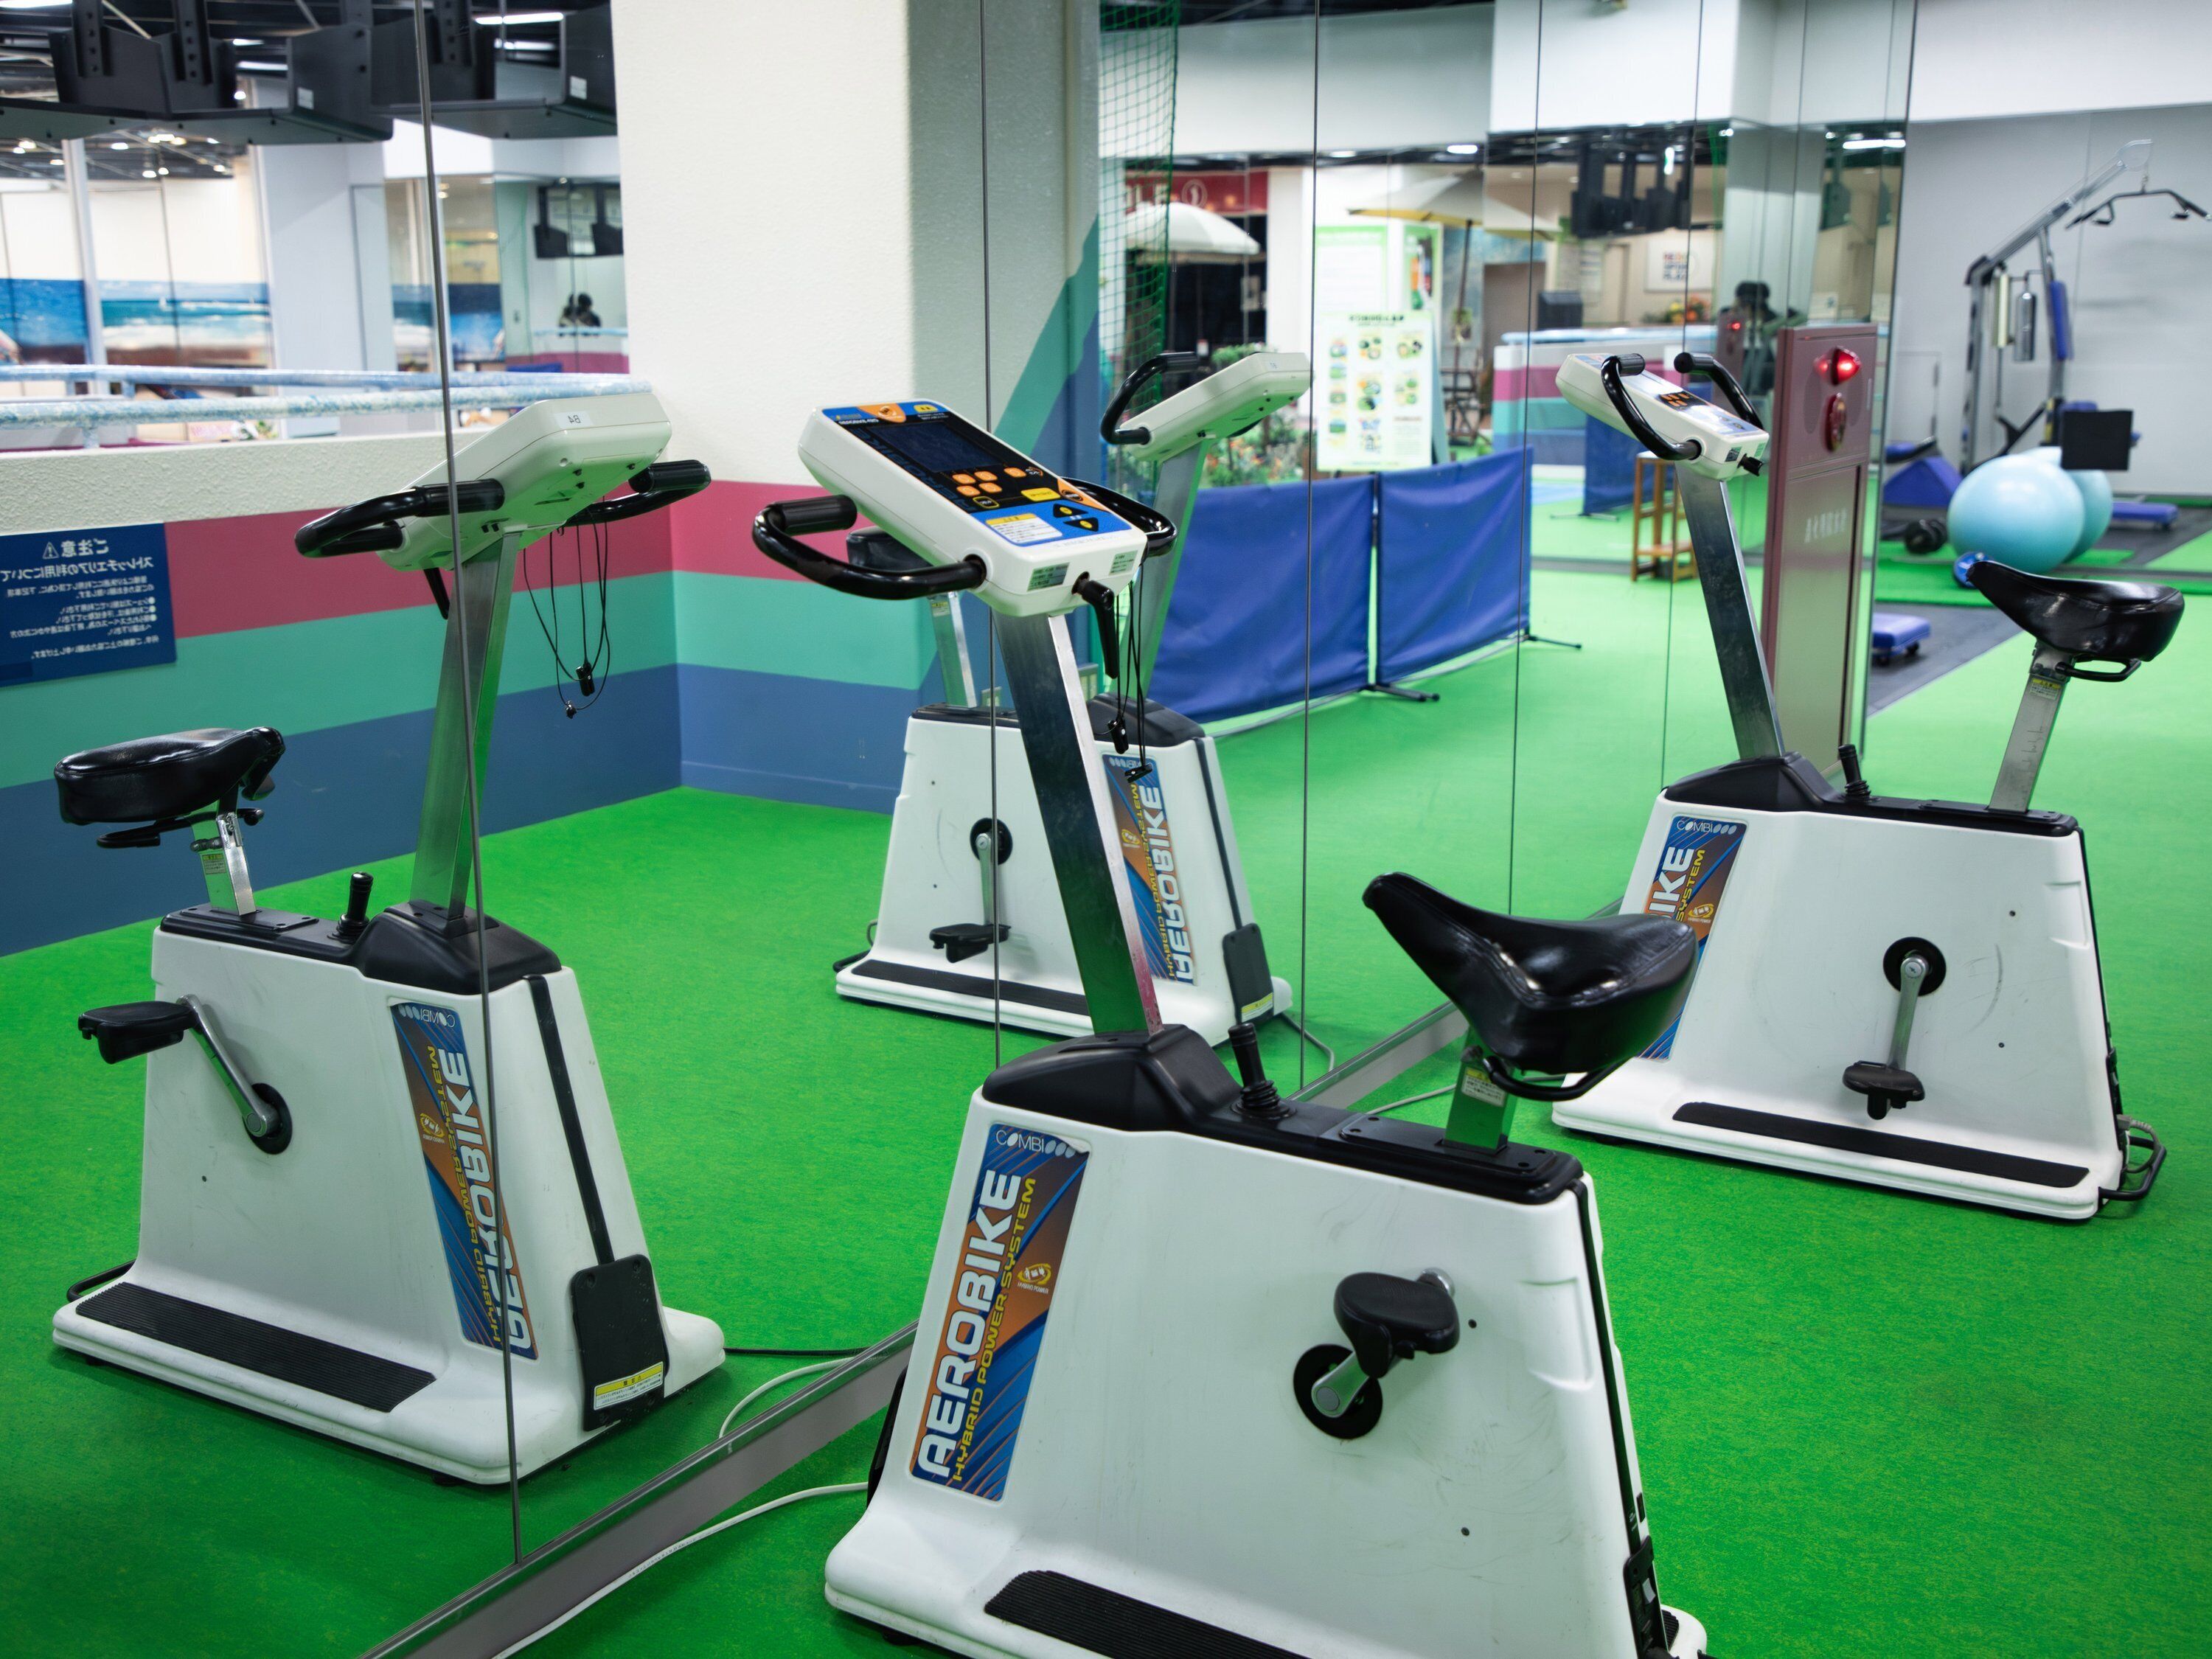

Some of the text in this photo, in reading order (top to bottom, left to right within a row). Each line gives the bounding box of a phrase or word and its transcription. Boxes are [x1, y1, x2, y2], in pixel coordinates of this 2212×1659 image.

[1648, 846, 1694, 918] IKE
[1675, 849, 1705, 922] SYSTEM
[918, 1169, 1021, 1477] AEROBIKE
[952, 1177, 1036, 1481] HYBRID POWER SYSTEM
